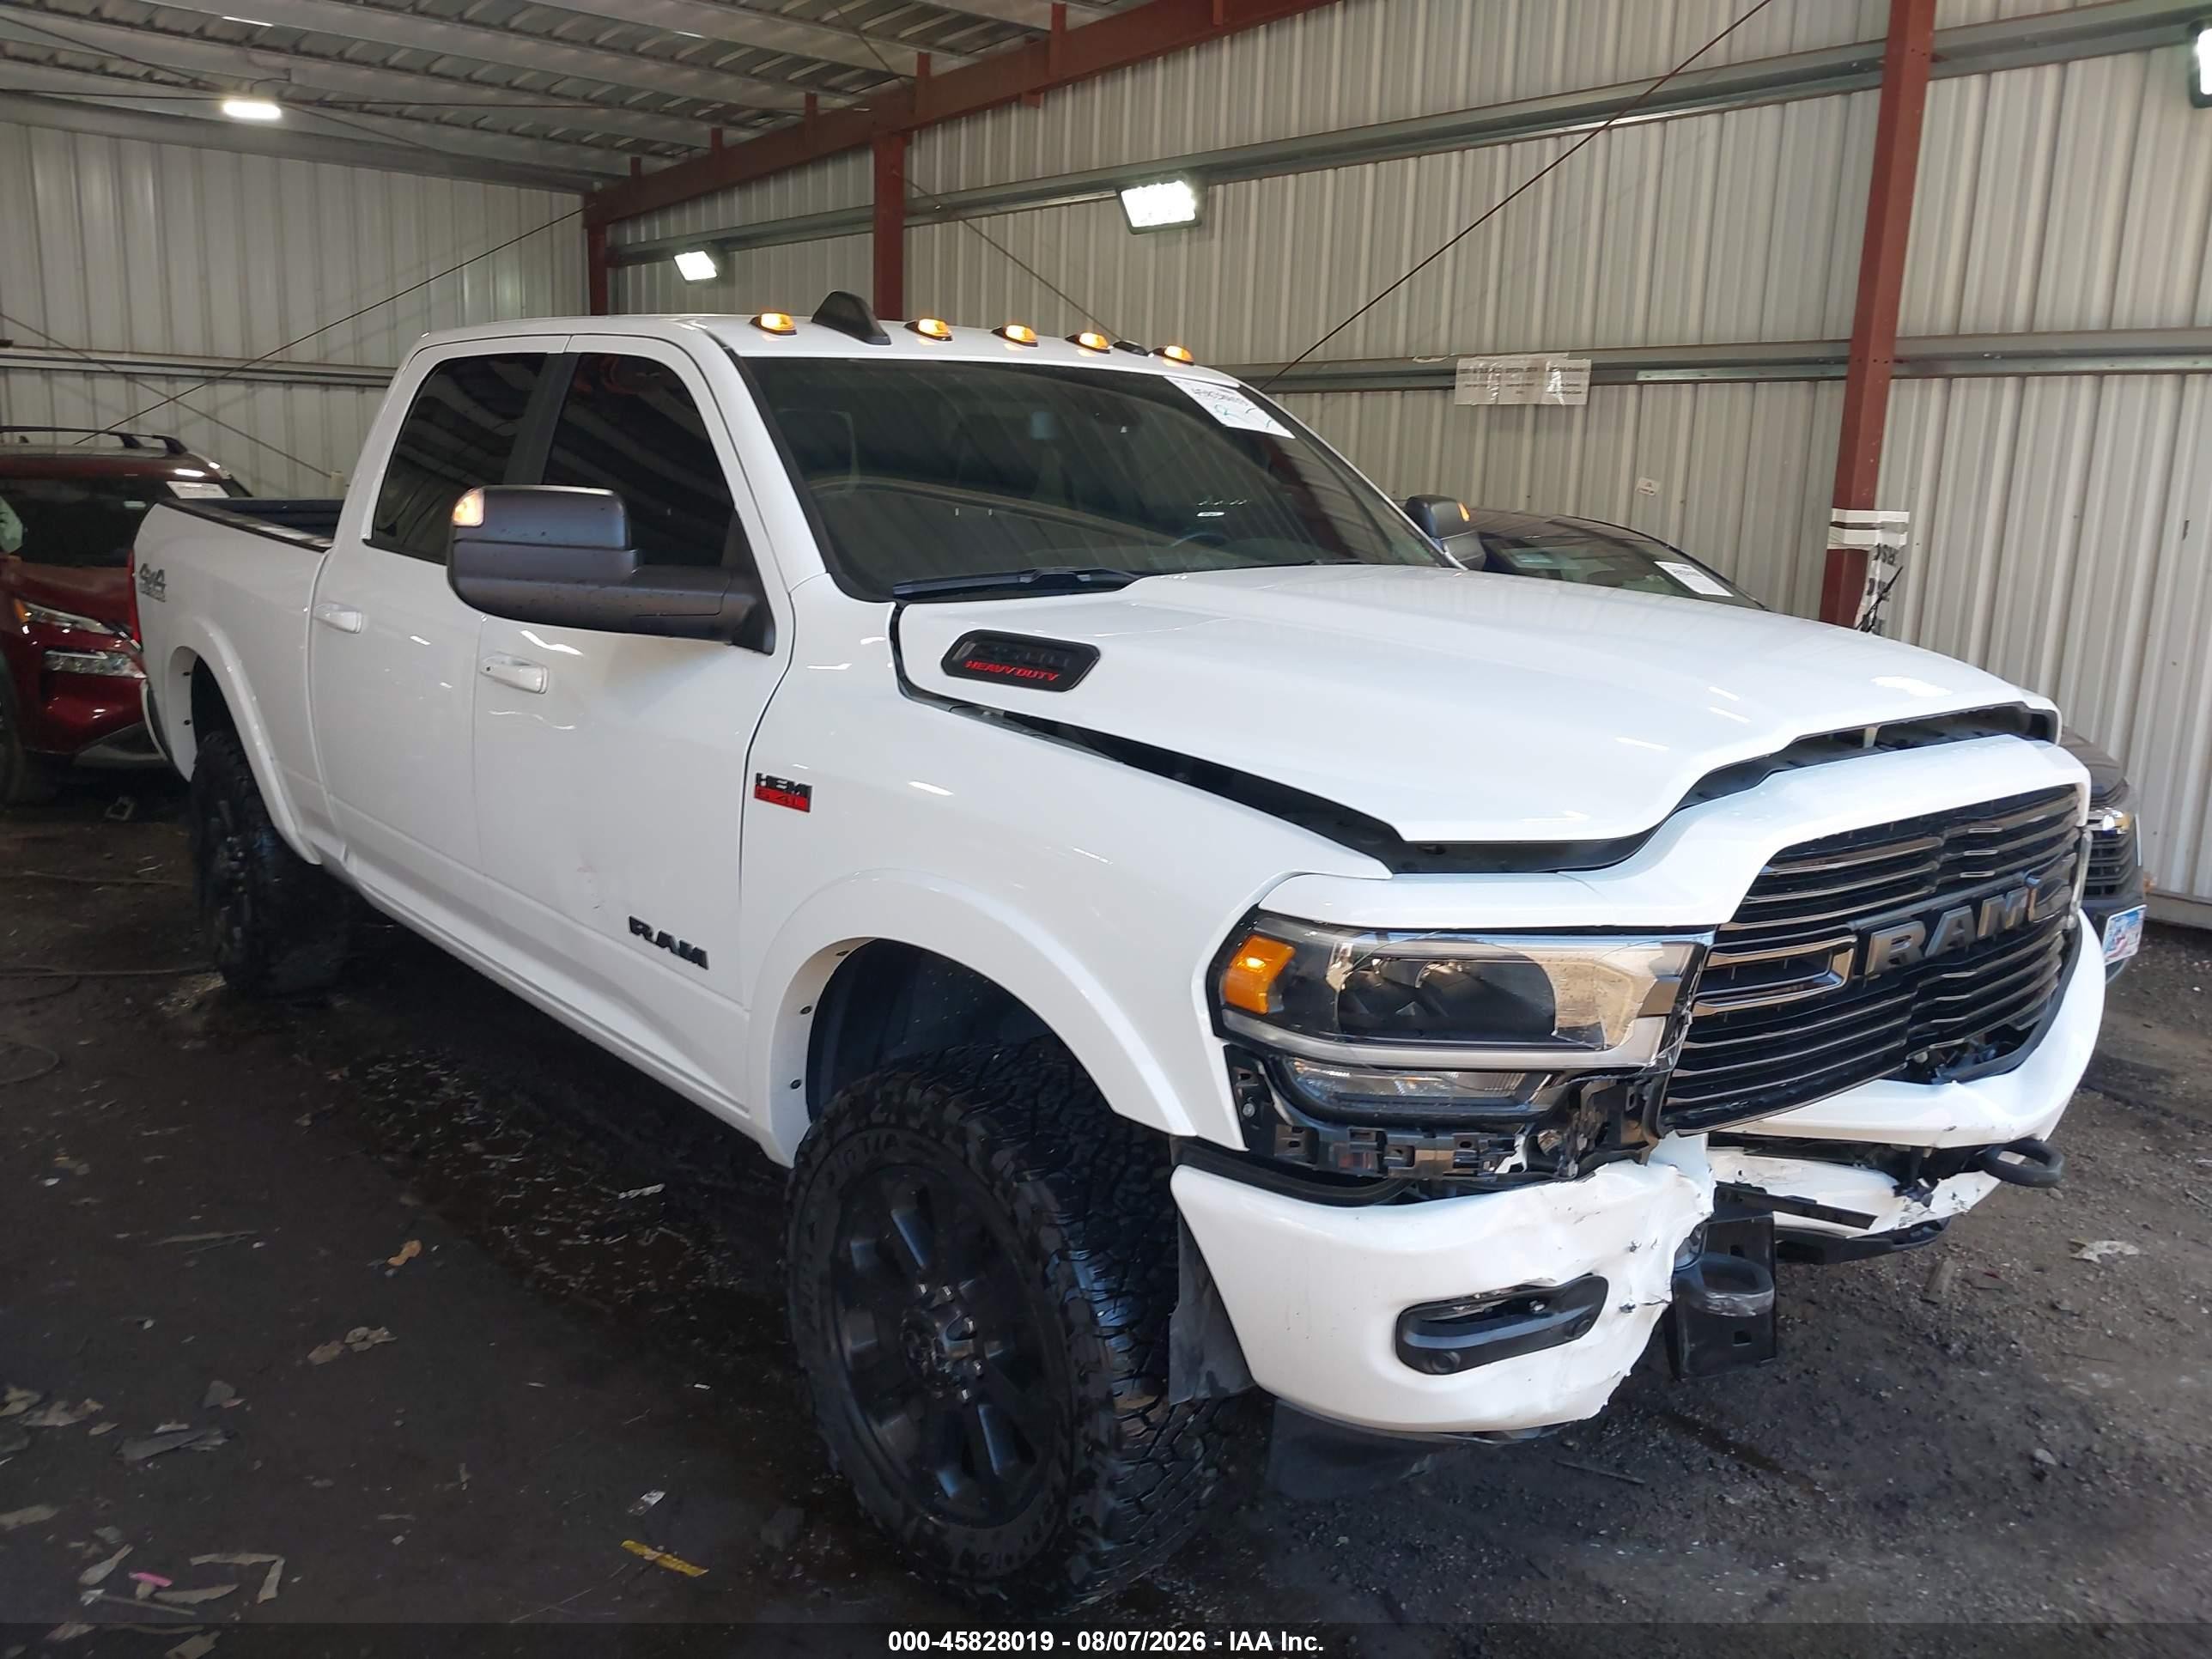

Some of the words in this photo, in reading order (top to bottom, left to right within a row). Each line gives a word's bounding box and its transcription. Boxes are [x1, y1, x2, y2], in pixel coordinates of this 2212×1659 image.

[963, 659, 1016, 675] HEAVY
[1014, 666, 1061, 682] DUTY
[629, 915, 709, 970] RAM
[1864, 886, 2029, 976] RAM
